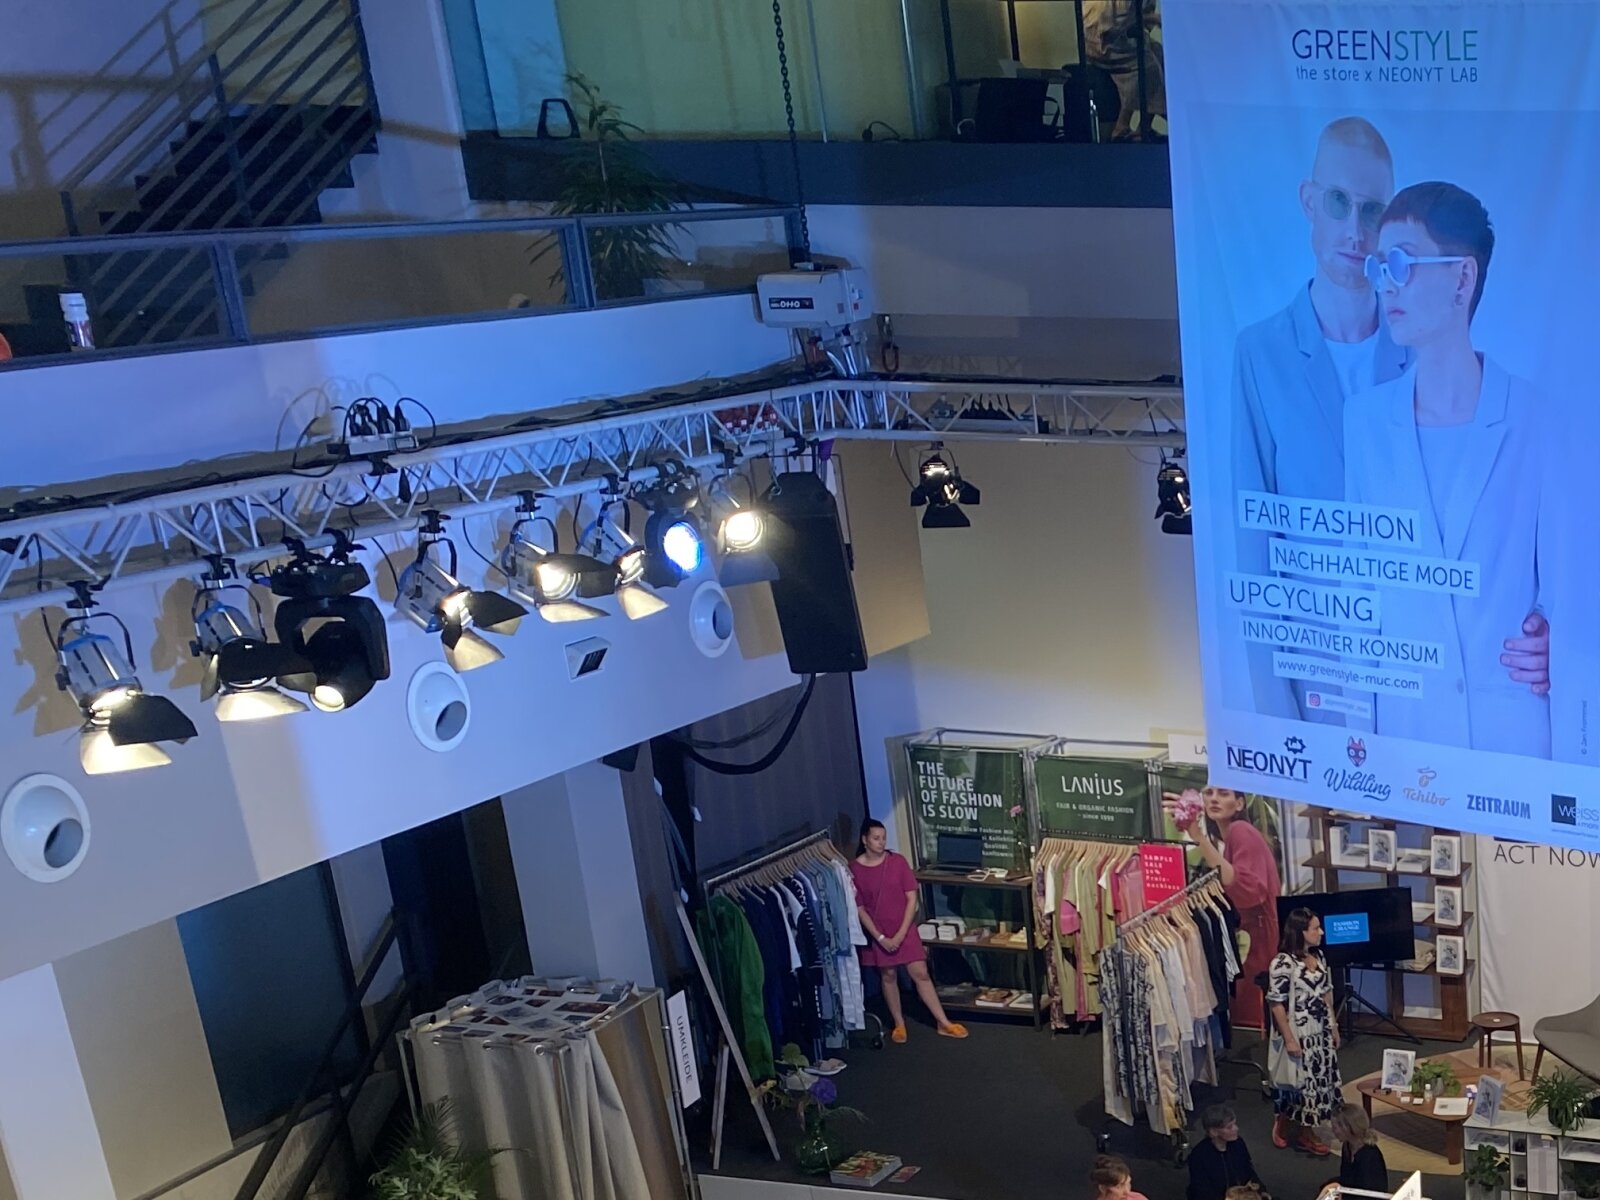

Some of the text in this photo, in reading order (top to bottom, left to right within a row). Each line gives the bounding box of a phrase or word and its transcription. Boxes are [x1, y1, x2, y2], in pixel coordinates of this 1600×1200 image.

[1291, 28, 1479, 62] GREENSTYLE
[1296, 65, 1478, 83] the store x NEONYT LAB
[1244, 498, 1415, 543] FAIR FASHION
[1275, 546, 1475, 591] NACHHALTIGE MODE
[1230, 579, 1373, 622] UPCYCLING
[1243, 620, 1439, 665] INNOVATIVER KONSUM
[1277, 659, 1420, 690] www.greenstyle-muc.com
[917, 761, 945, 776] THE
[1226, 746, 1312, 780] NEONYT
[919, 775, 974, 792] FUTURE
[1323, 767, 1392, 801] Wildling
[1403, 786, 1450, 807] Tchibo
[921, 789, 1003, 808] OF FASHION
[922, 804, 978, 821] IS SLOW
[1056, 802, 1070, 810] FAIR
[1078, 803, 1106, 812] ORGANIC
[1108, 806, 1134, 814] FASHION
[1467, 793, 1531, 820] ZEITRAUM
[1494, 843, 1541, 865] ACT
[676, 1015, 693, 1084] UMKLEIDE
